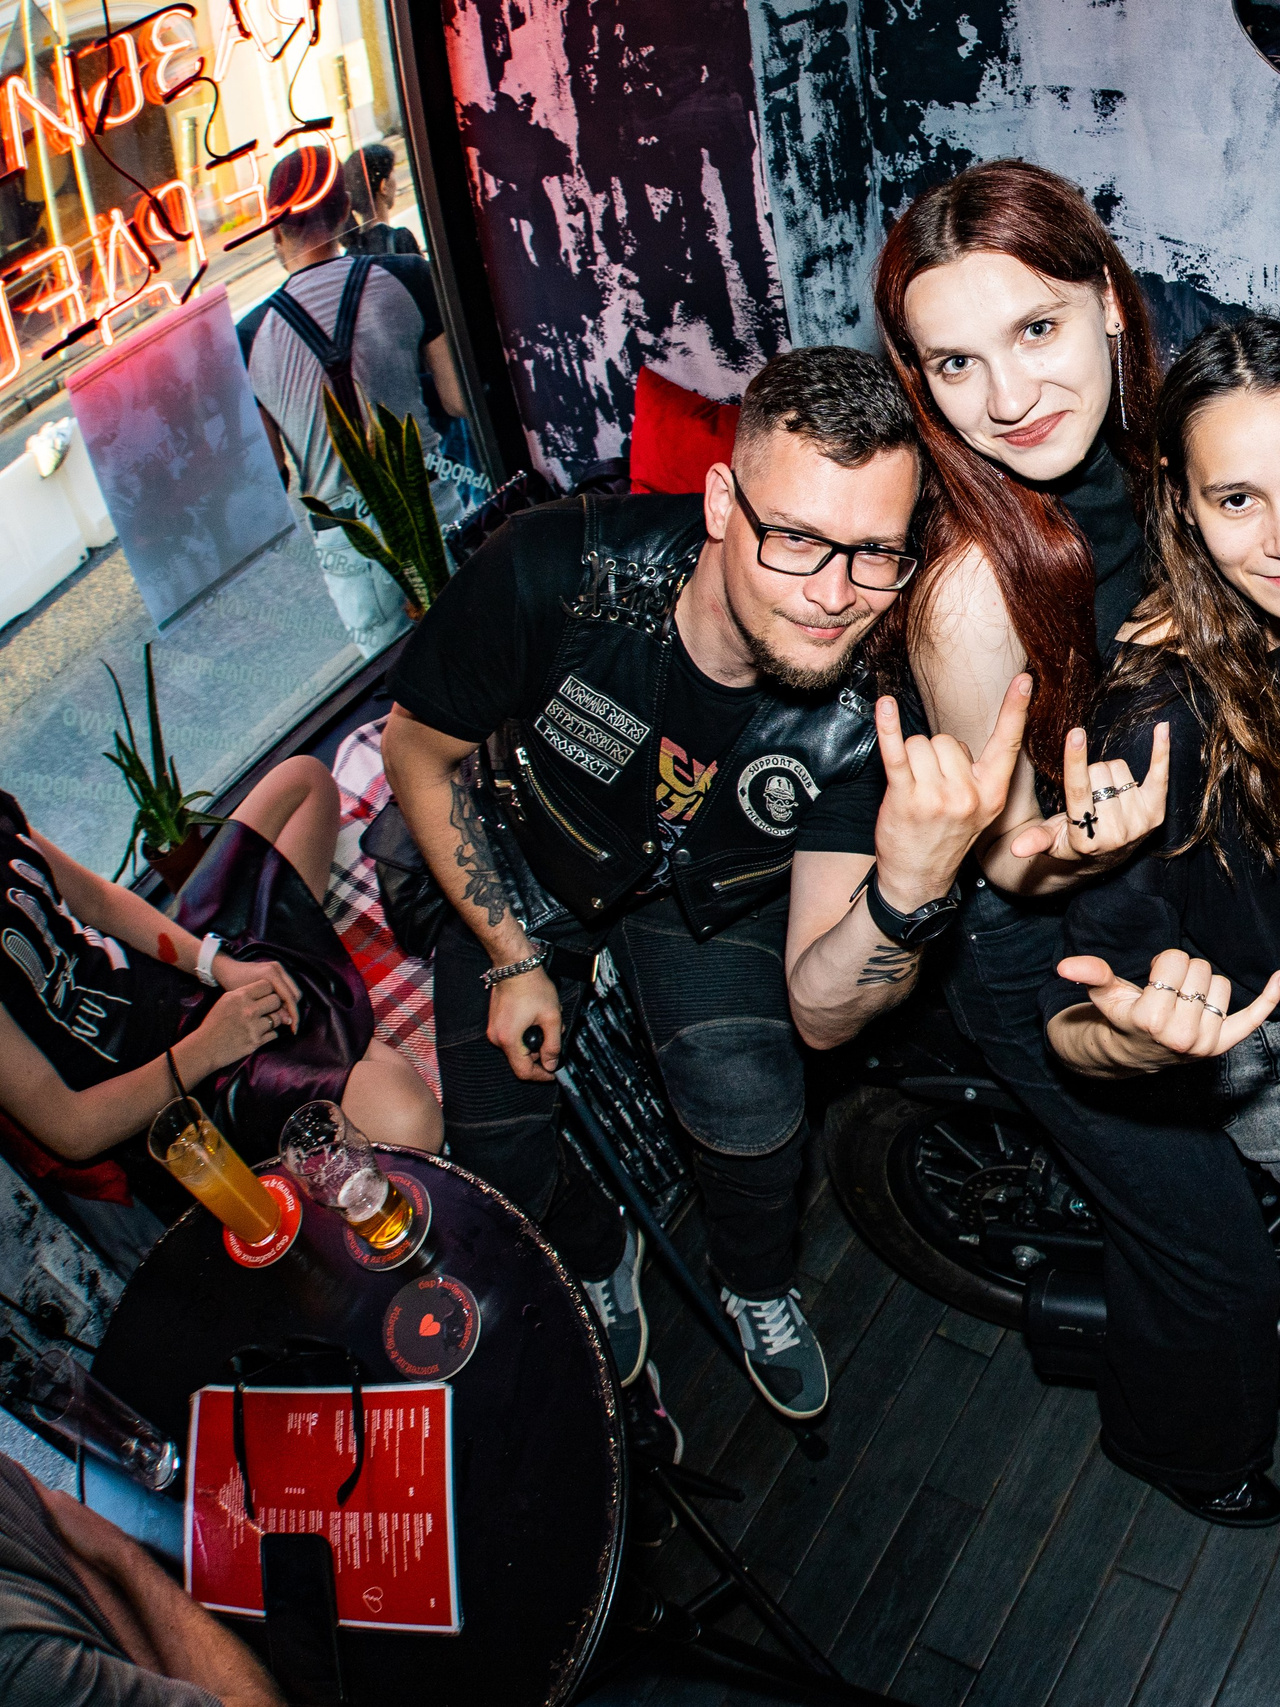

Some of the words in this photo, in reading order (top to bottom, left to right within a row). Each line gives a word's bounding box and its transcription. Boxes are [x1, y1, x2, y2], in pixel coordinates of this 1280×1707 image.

[563, 680, 610, 715] NORMANS
[606, 708, 644, 740] RIDERS
[543, 725, 609, 776] PROSPECT
[748, 757, 793, 776] SUPPORT
[793, 765, 812, 789] CLUB
[745, 806, 760, 824] THE
[275, 1235, 289, 1251] бар
[346, 1228, 364, 1259] бильяр
[418, 1279, 436, 1290] бар
[385, 1305, 403, 1350] бильярд
[390, 1350, 399, 1359] &
[396, 1356, 440, 1375] коктейли
